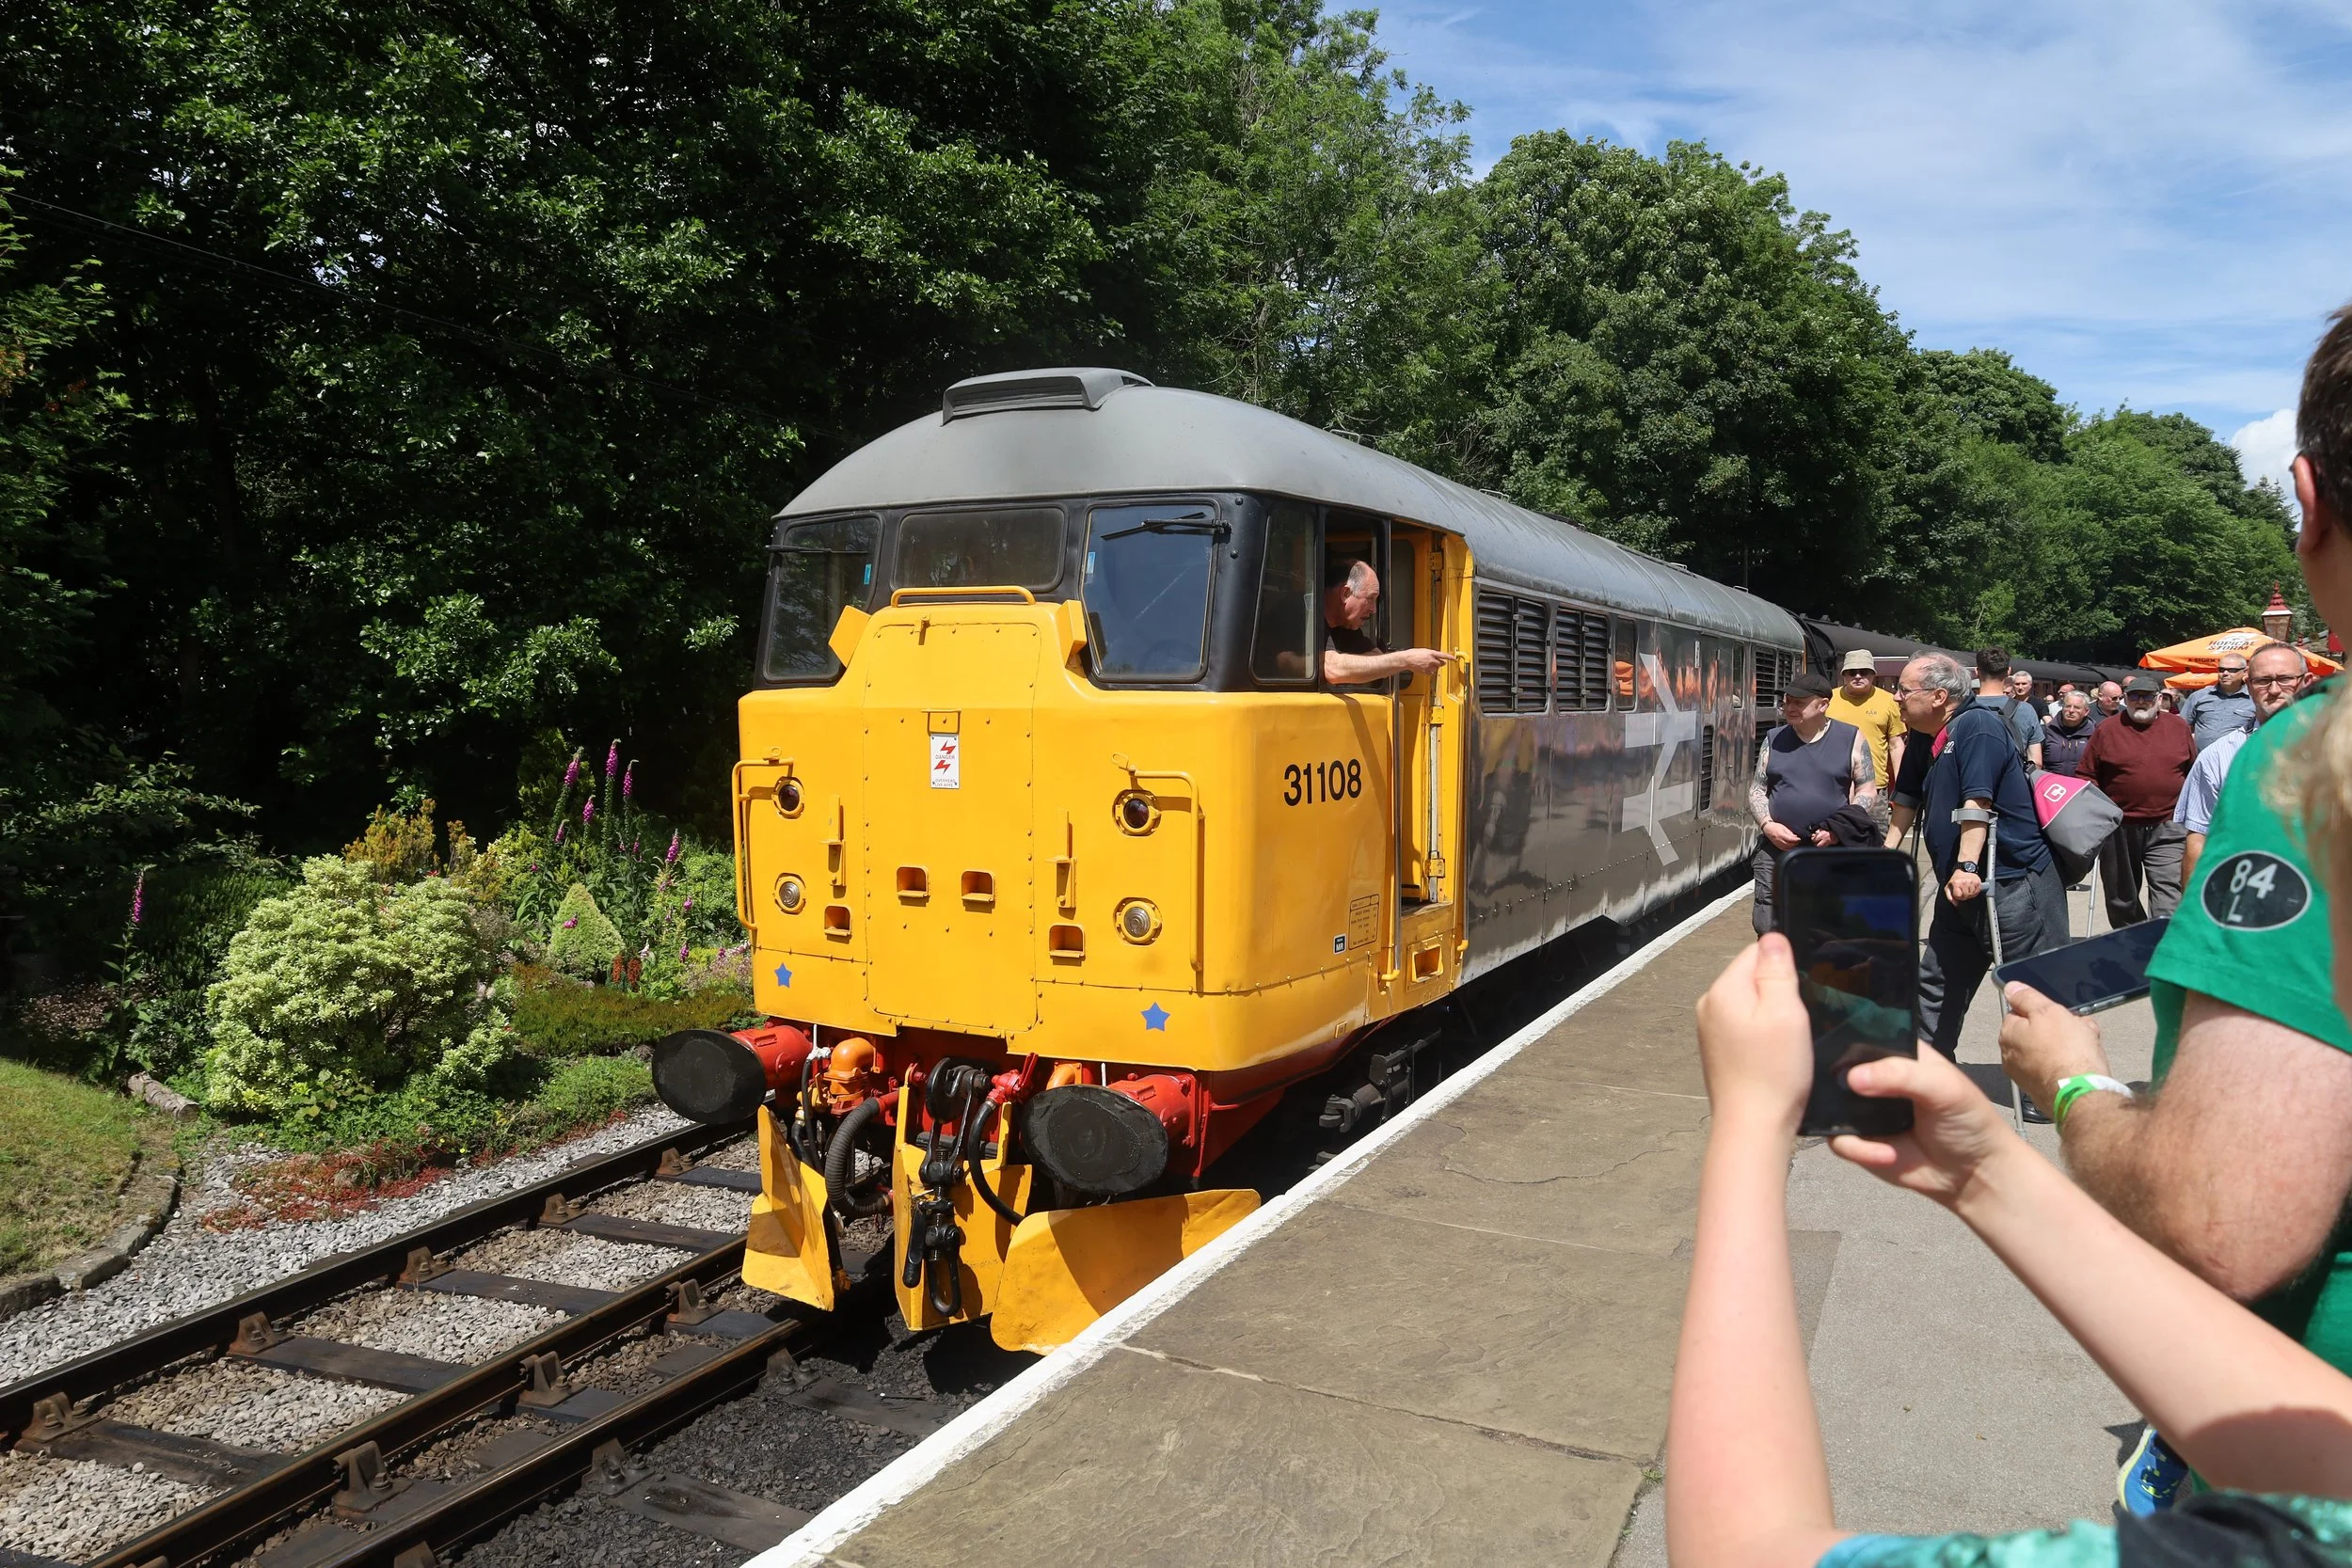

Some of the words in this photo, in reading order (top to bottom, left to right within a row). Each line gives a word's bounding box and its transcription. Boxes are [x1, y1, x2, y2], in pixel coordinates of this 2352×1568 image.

[1283, 758, 1362, 806] 31108
[2229, 859, 2279, 899] 84
[1336, 942, 1344, 951] MR
